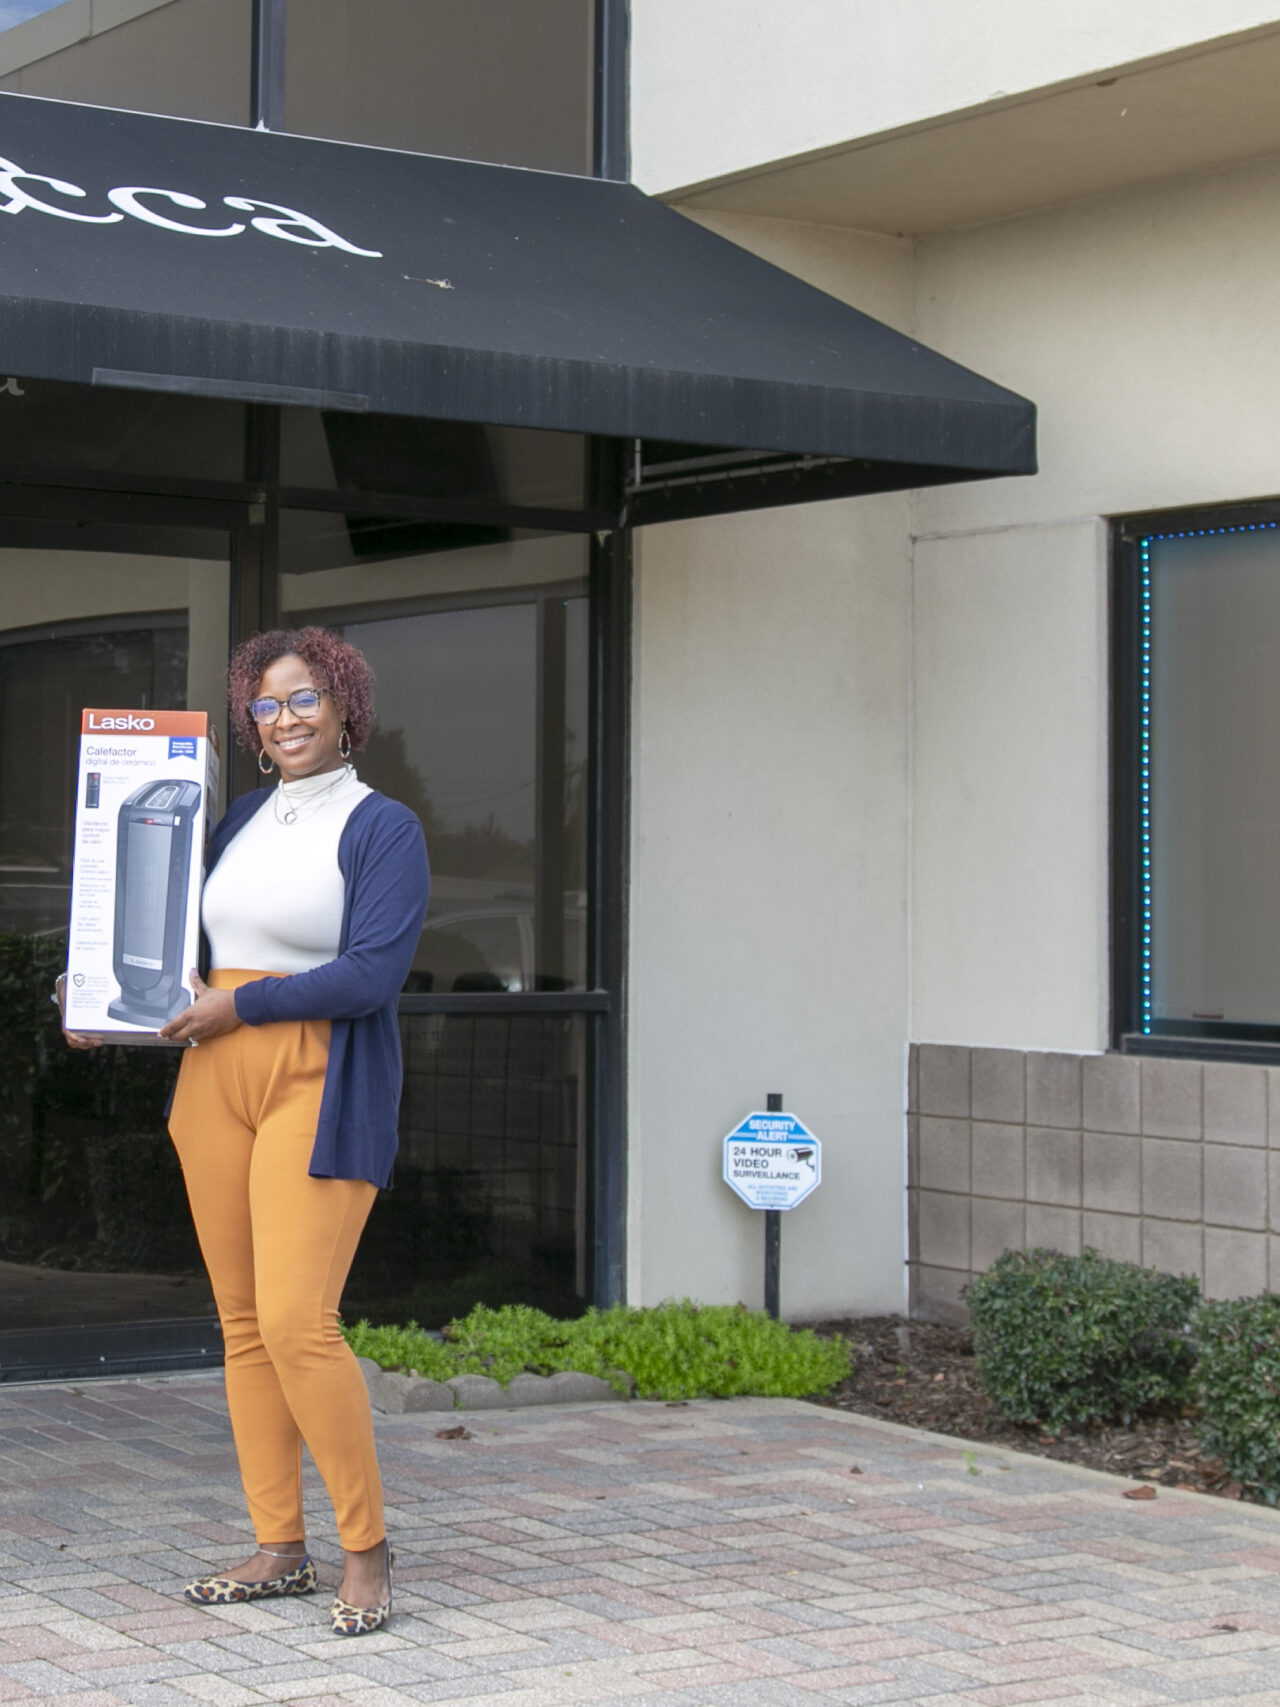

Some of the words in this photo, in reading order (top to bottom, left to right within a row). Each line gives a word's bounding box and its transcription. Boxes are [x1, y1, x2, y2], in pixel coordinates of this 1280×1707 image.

[88, 713, 155, 731] Lasko
[86, 746, 137, 757] Calefactor
[749, 1120, 795, 1132] SECURITY
[756, 1131, 789, 1142] ALERT
[733, 1146, 747, 1157] 24
[750, 1147, 783, 1158] HOUR
[733, 1159, 770, 1169] VIDEO
[733, 1170, 801, 1181] SURVEILLANCE
